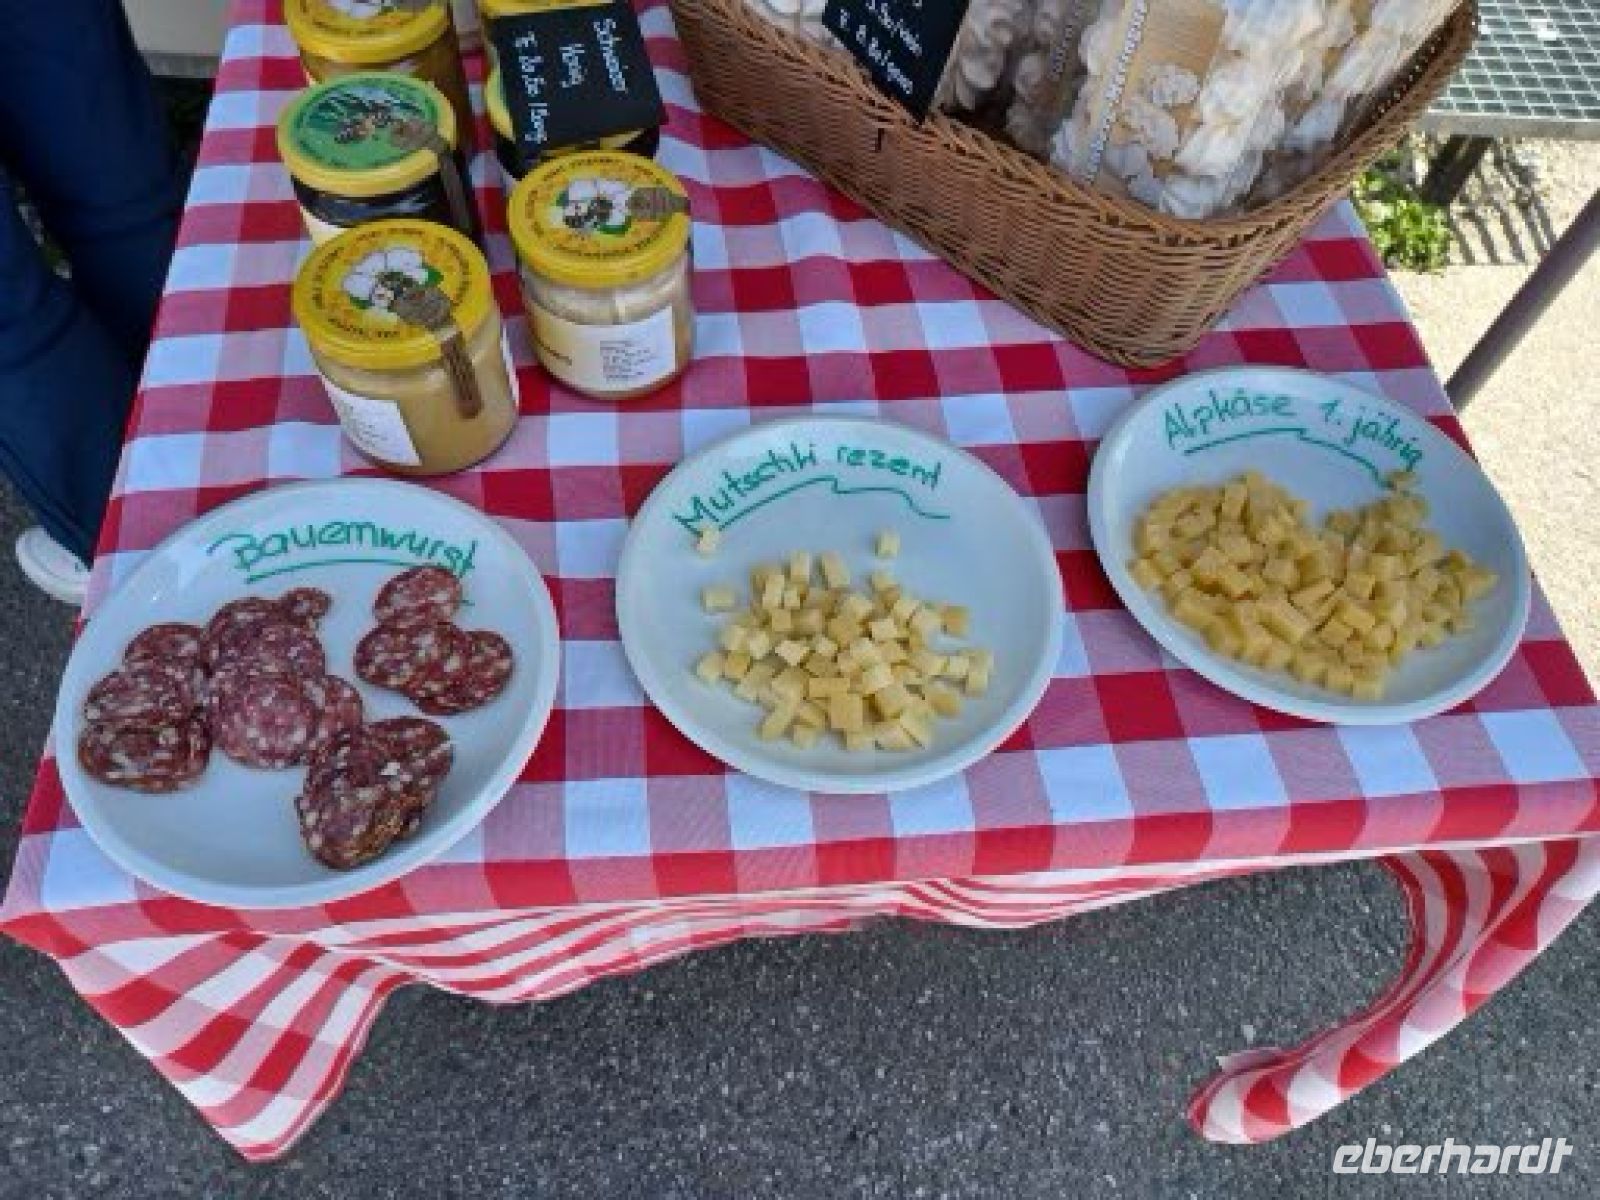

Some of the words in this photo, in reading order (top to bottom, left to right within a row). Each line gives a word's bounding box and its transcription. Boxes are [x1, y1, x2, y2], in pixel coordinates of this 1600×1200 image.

[1164, 387, 1298, 452] Alpkäse
[1343, 404, 1424, 473] jährig
[673, 440, 818, 539] Mutschli
[835, 444, 943, 491] rezent
[206, 520, 478, 579] Bauernwurst
